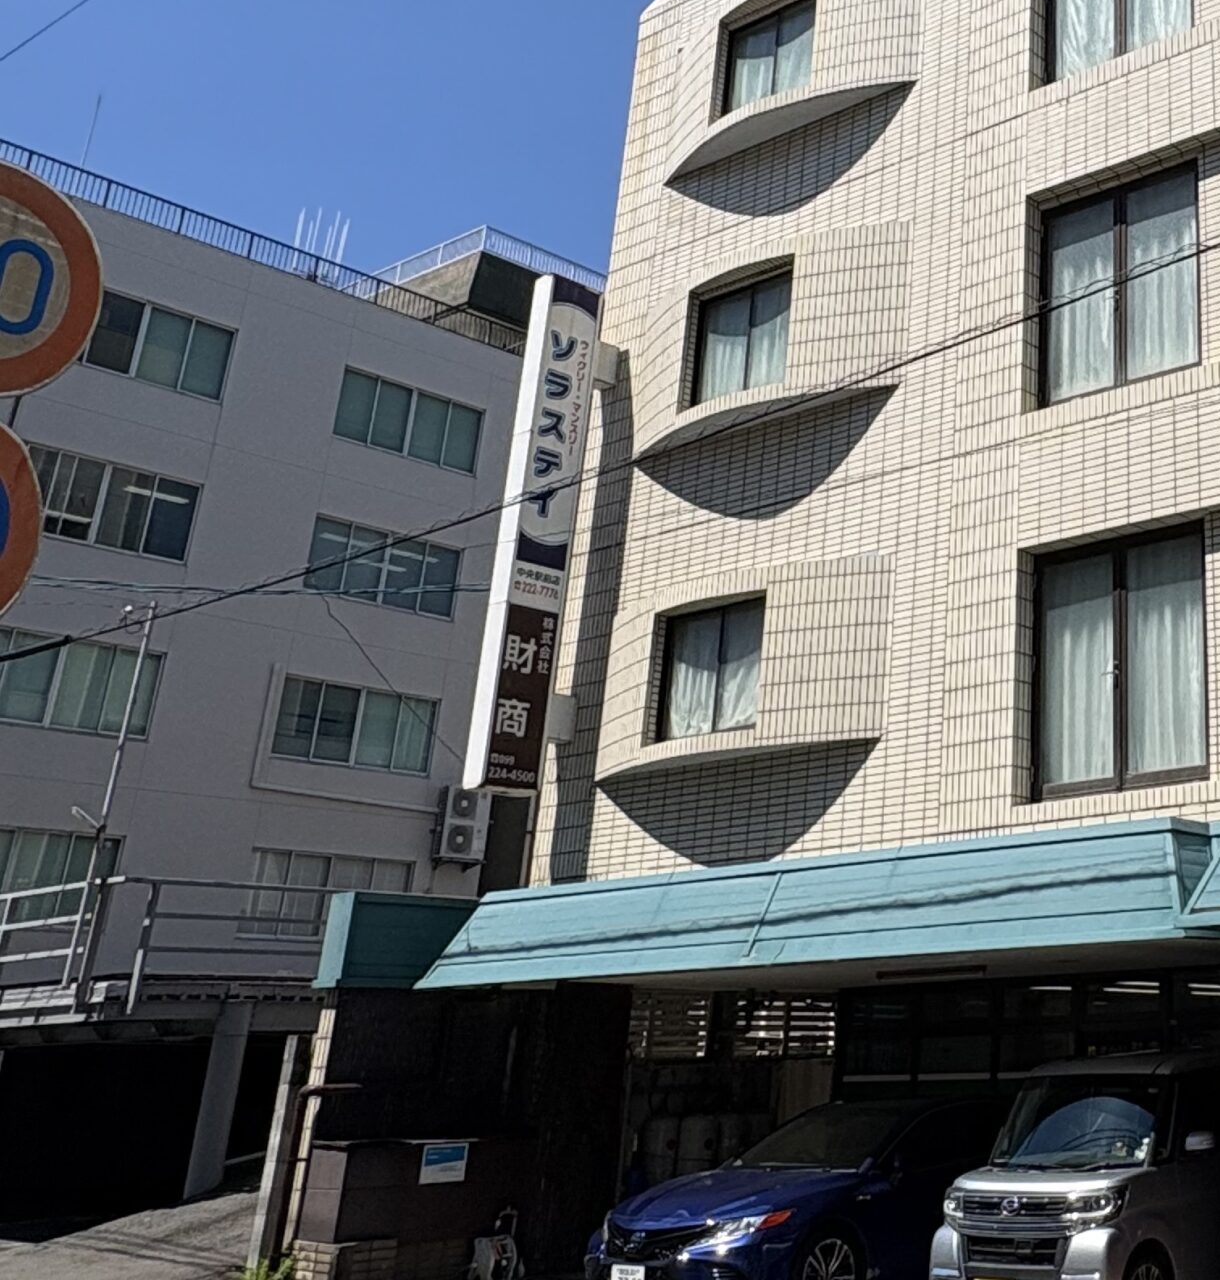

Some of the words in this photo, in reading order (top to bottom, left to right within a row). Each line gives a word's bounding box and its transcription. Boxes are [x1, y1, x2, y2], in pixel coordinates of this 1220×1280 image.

[536, 617, 554, 675] 株式会社
[495, 634, 538, 738] 財商
[487, 766, 536, 783] 224-4500
